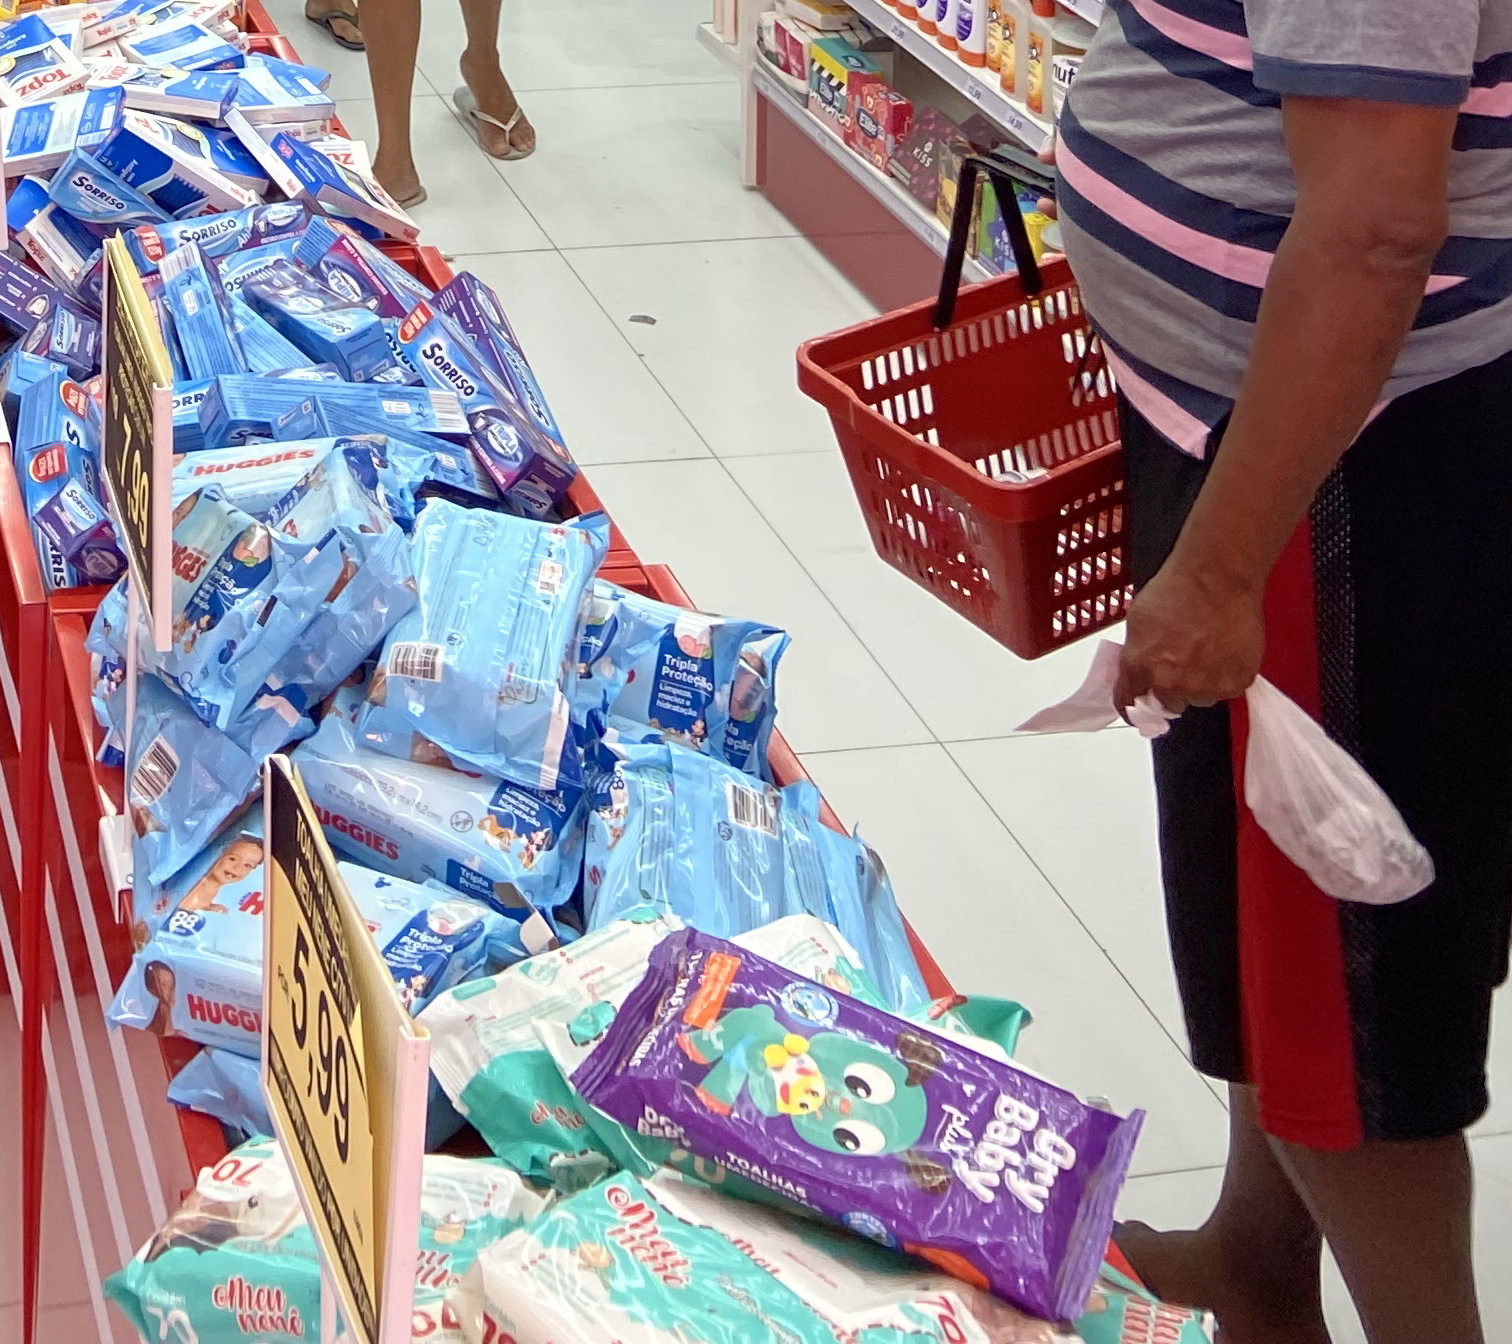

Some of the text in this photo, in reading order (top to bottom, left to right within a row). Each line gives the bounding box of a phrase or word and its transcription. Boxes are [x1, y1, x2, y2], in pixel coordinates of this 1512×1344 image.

[16, 67, 72, 98] Topz
[913, 146, 934, 168] KISS
[72, 175, 125, 210] SORRISO
[178, 218, 238, 243] SORRISO
[421, 342, 476, 398] SORRISO
[193, 448, 316, 477] HUGGIES
[661, 665, 714, 692] Proteção
[663, 653, 699, 673] Tripla
[291, 926, 350, 1164] 5,99
[951, 1093, 1040, 1204] Baby
[726, 1150, 807, 1198] TOALHAS
[1004, 1128, 1077, 1214] Dry
[211, 1275, 287, 1312] Meu
